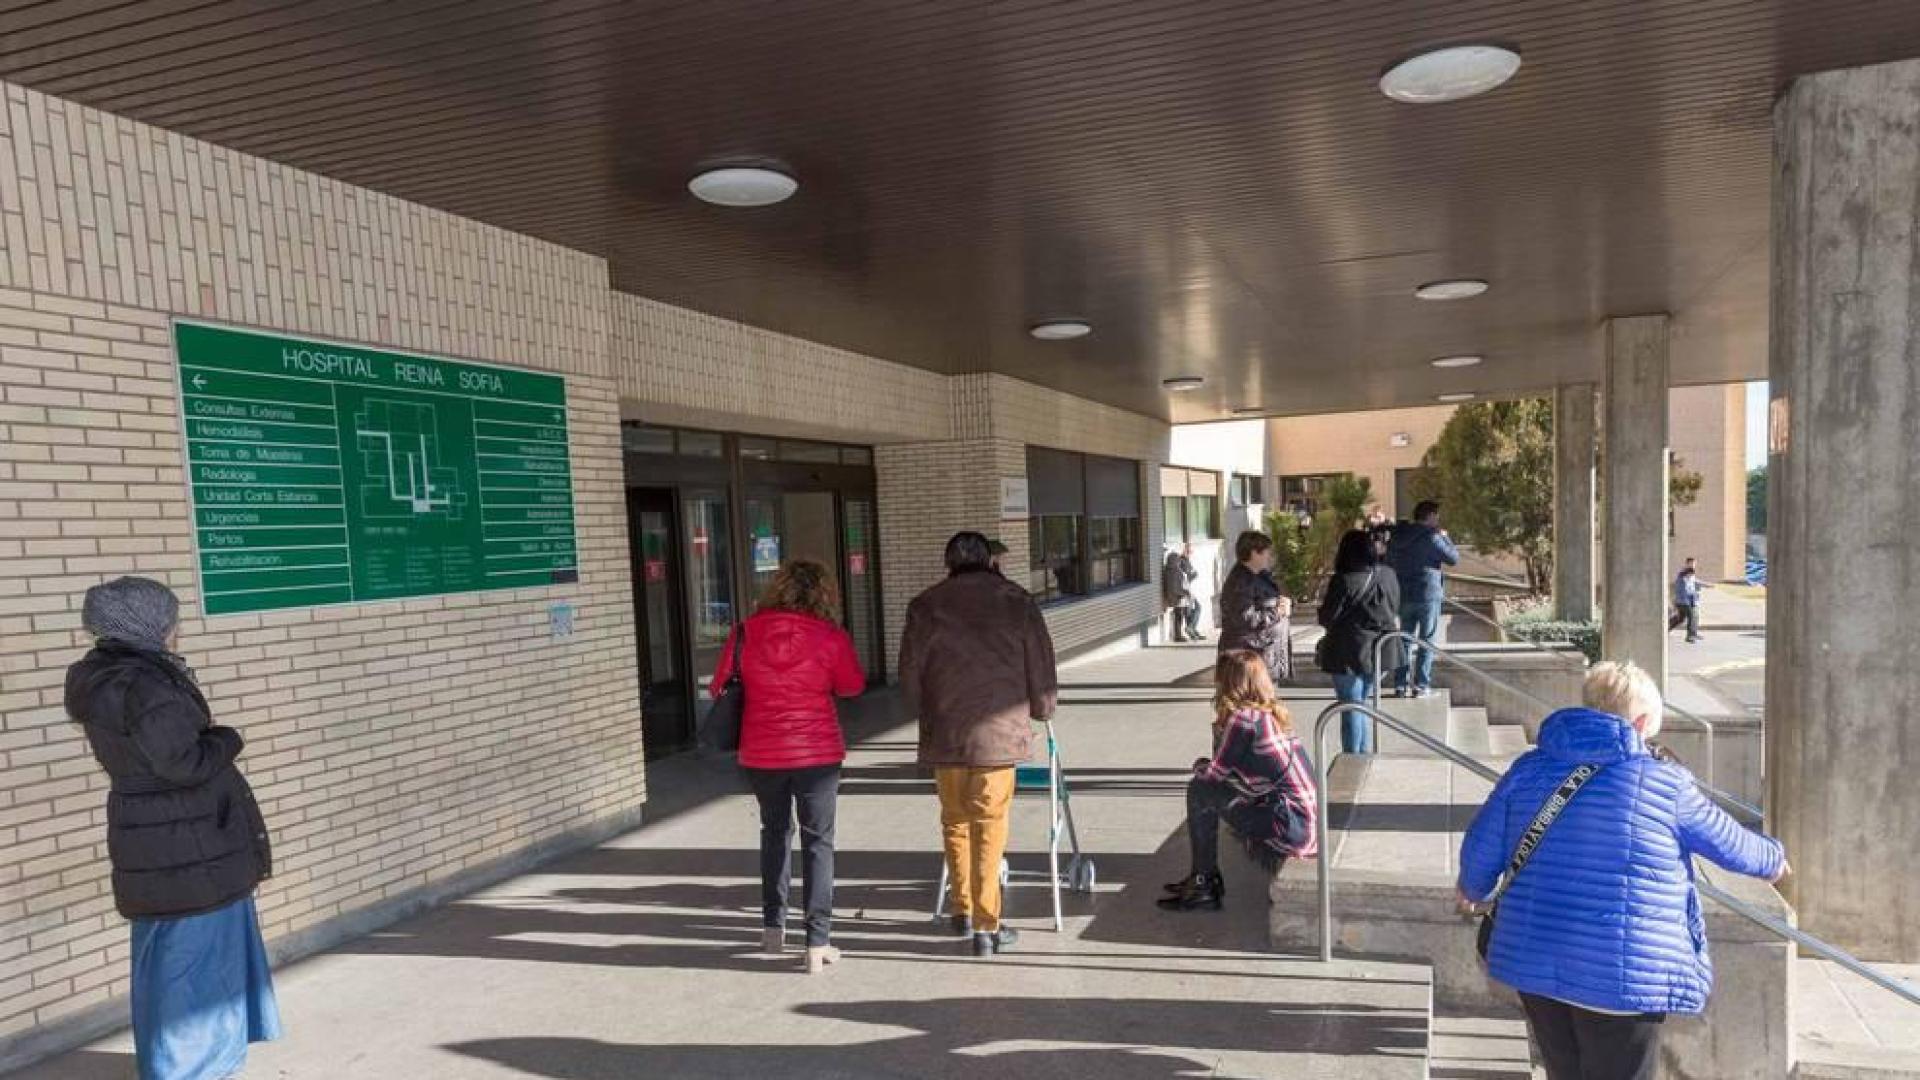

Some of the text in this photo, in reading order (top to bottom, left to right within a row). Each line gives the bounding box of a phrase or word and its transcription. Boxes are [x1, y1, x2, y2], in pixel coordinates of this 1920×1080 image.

[282, 348, 378, 378] HOSPITAL
[394, 362, 444, 386] REINA
[194, 400, 247, 416] Consultas
[199, 445, 230, 459] Toma
[236, 448, 251, 460] de
[203, 488, 241, 502] Unidad
[205, 511, 260, 525] Urgencias
[207, 532, 245, 546] Partos
